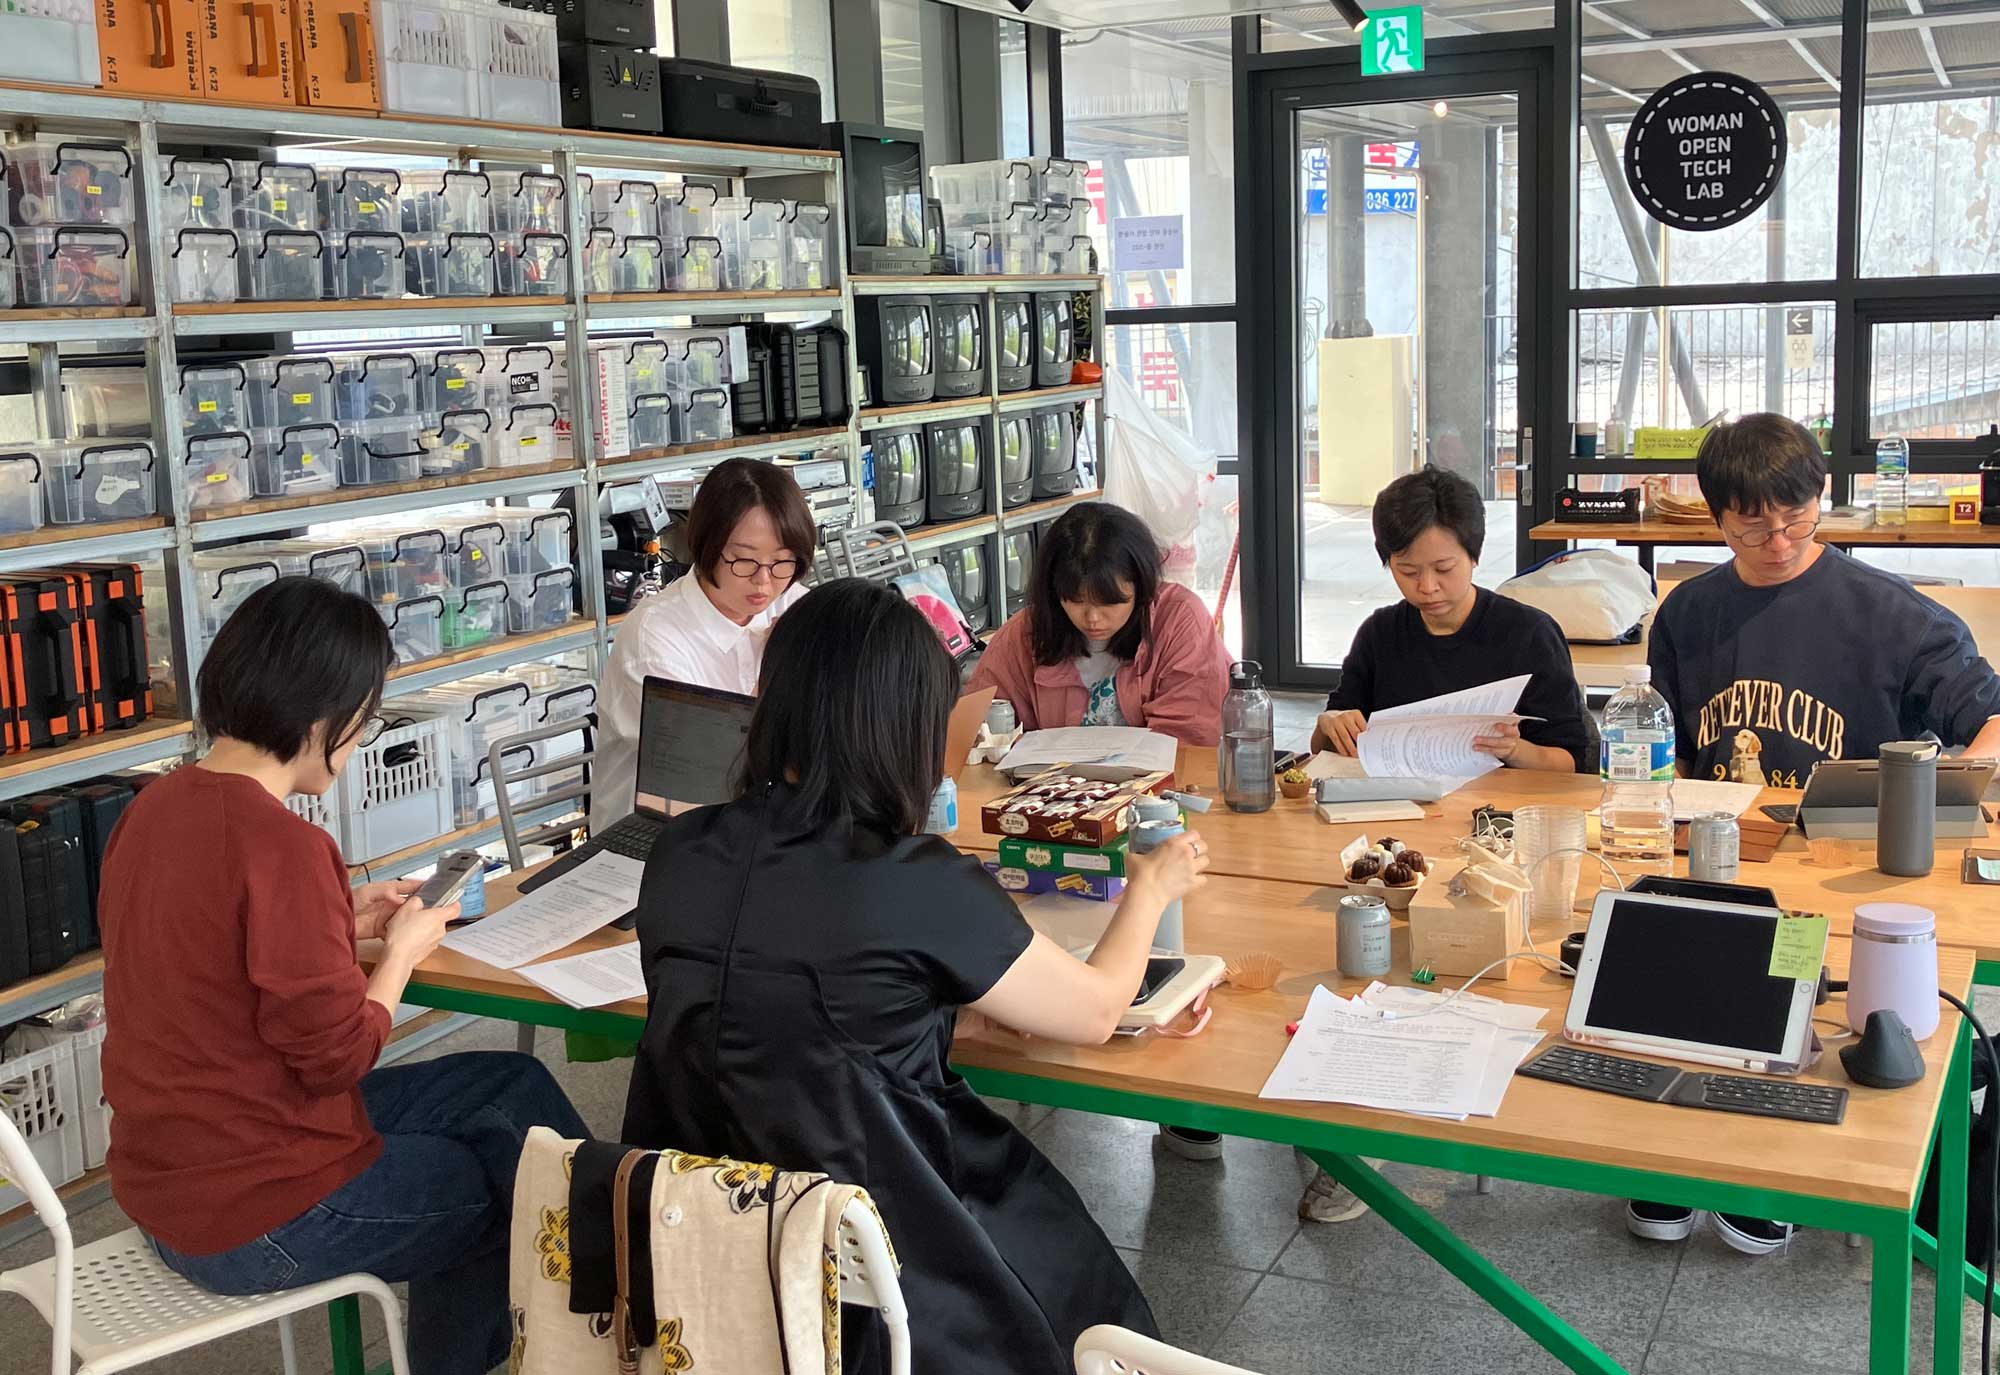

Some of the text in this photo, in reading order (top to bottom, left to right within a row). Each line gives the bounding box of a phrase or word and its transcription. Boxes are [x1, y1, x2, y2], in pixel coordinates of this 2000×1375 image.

[1667, 112, 1743, 134] WOMAN
[1679, 136, 1731, 156] OPEN
[1679, 158, 1731, 178] TECH
[1686, 182, 1724, 200] LAB
[1958, 503, 1972, 513] T2
[1786, 688, 1845, 760] CLUB
